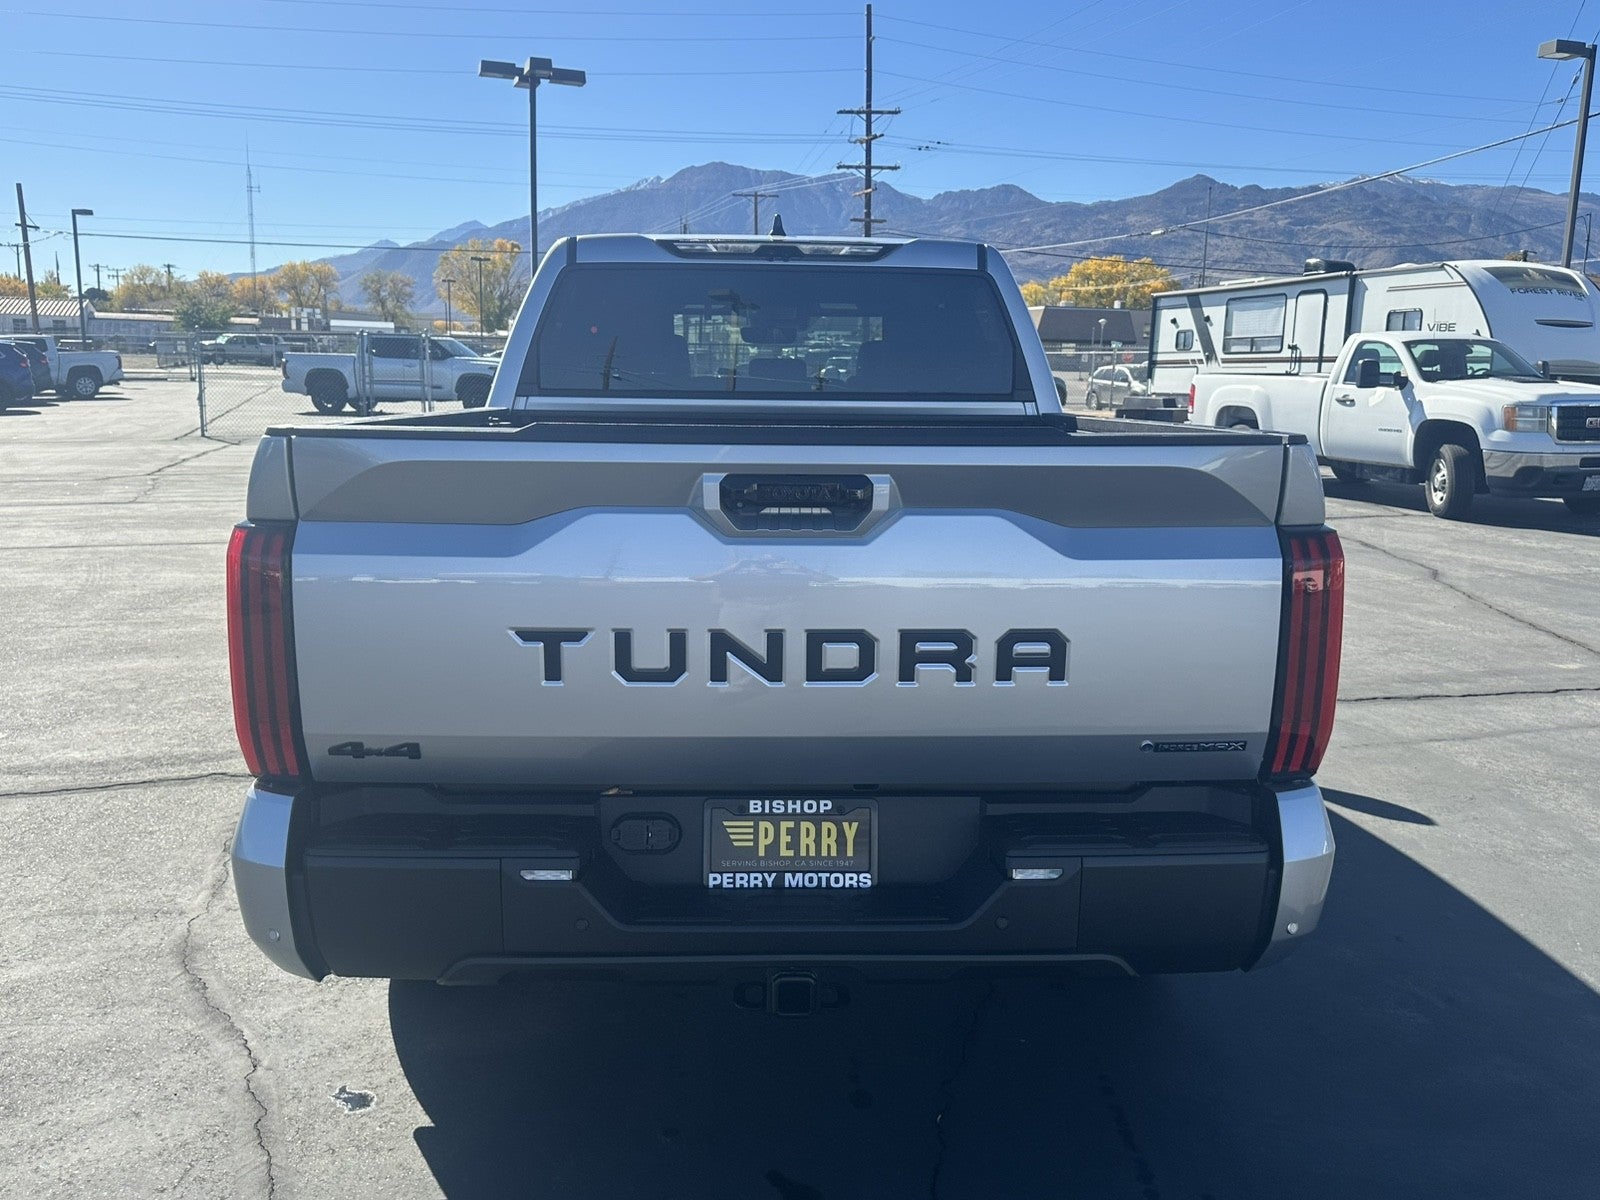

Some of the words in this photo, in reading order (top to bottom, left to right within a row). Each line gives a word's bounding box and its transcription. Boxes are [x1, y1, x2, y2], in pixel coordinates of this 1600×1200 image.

[1427, 322, 1457, 332] VIBE
[506, 627, 1071, 688] TUNDRA
[749, 799, 833, 814] BISHOP
[758, 820, 859, 857] PERRY
[708, 872, 777, 889] PERRY
[784, 872, 872, 888] MOTORS
